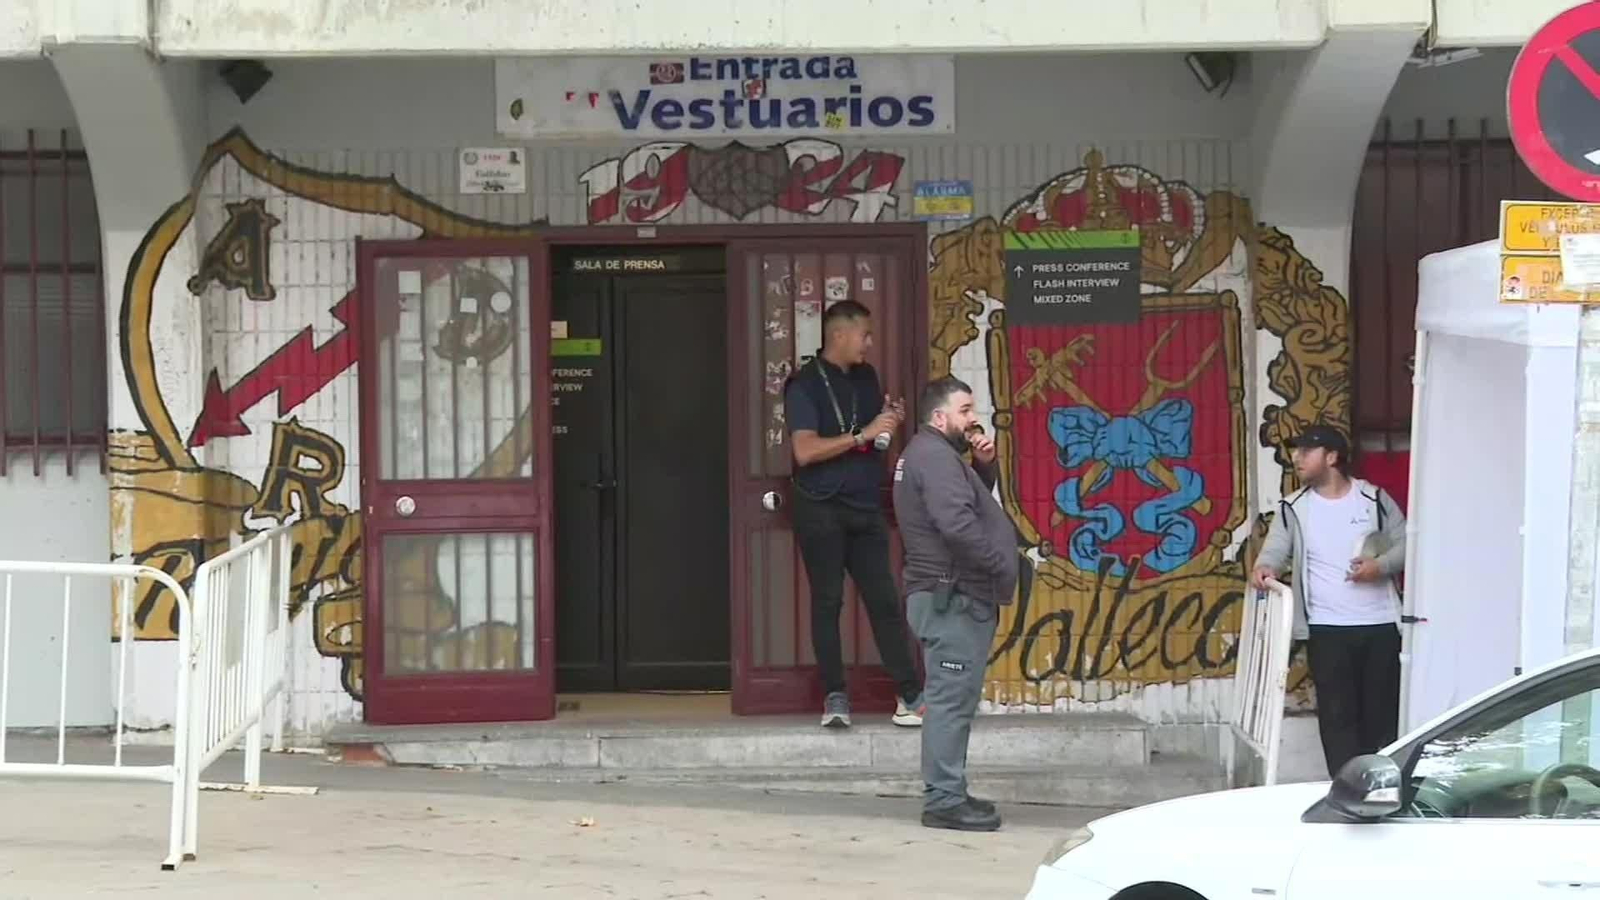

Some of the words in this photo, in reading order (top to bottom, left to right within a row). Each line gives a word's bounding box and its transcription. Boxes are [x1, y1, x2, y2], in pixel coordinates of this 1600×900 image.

[690, 57, 857, 80] Entrada
[608, 85, 935, 130] Vestuarios
[1541, 207, 1594, 219] EXCEP
[574, 260, 602, 270] SALA
[605, 260, 621, 270] DE
[624, 260, 665, 270] PRENSA
[1032, 264, 1063, 273] PRESS
[1065, 262, 1130, 272] CONFERENCE
[1034, 280, 1064, 289] FLASH
[1066, 278, 1120, 288] INTERVIEW
[1034, 295, 1063, 304] MIXED
[1065, 294, 1092, 303] ZONE
[552, 368, 593, 377] FERENCE
[552, 383, 583, 392] RVIEW
